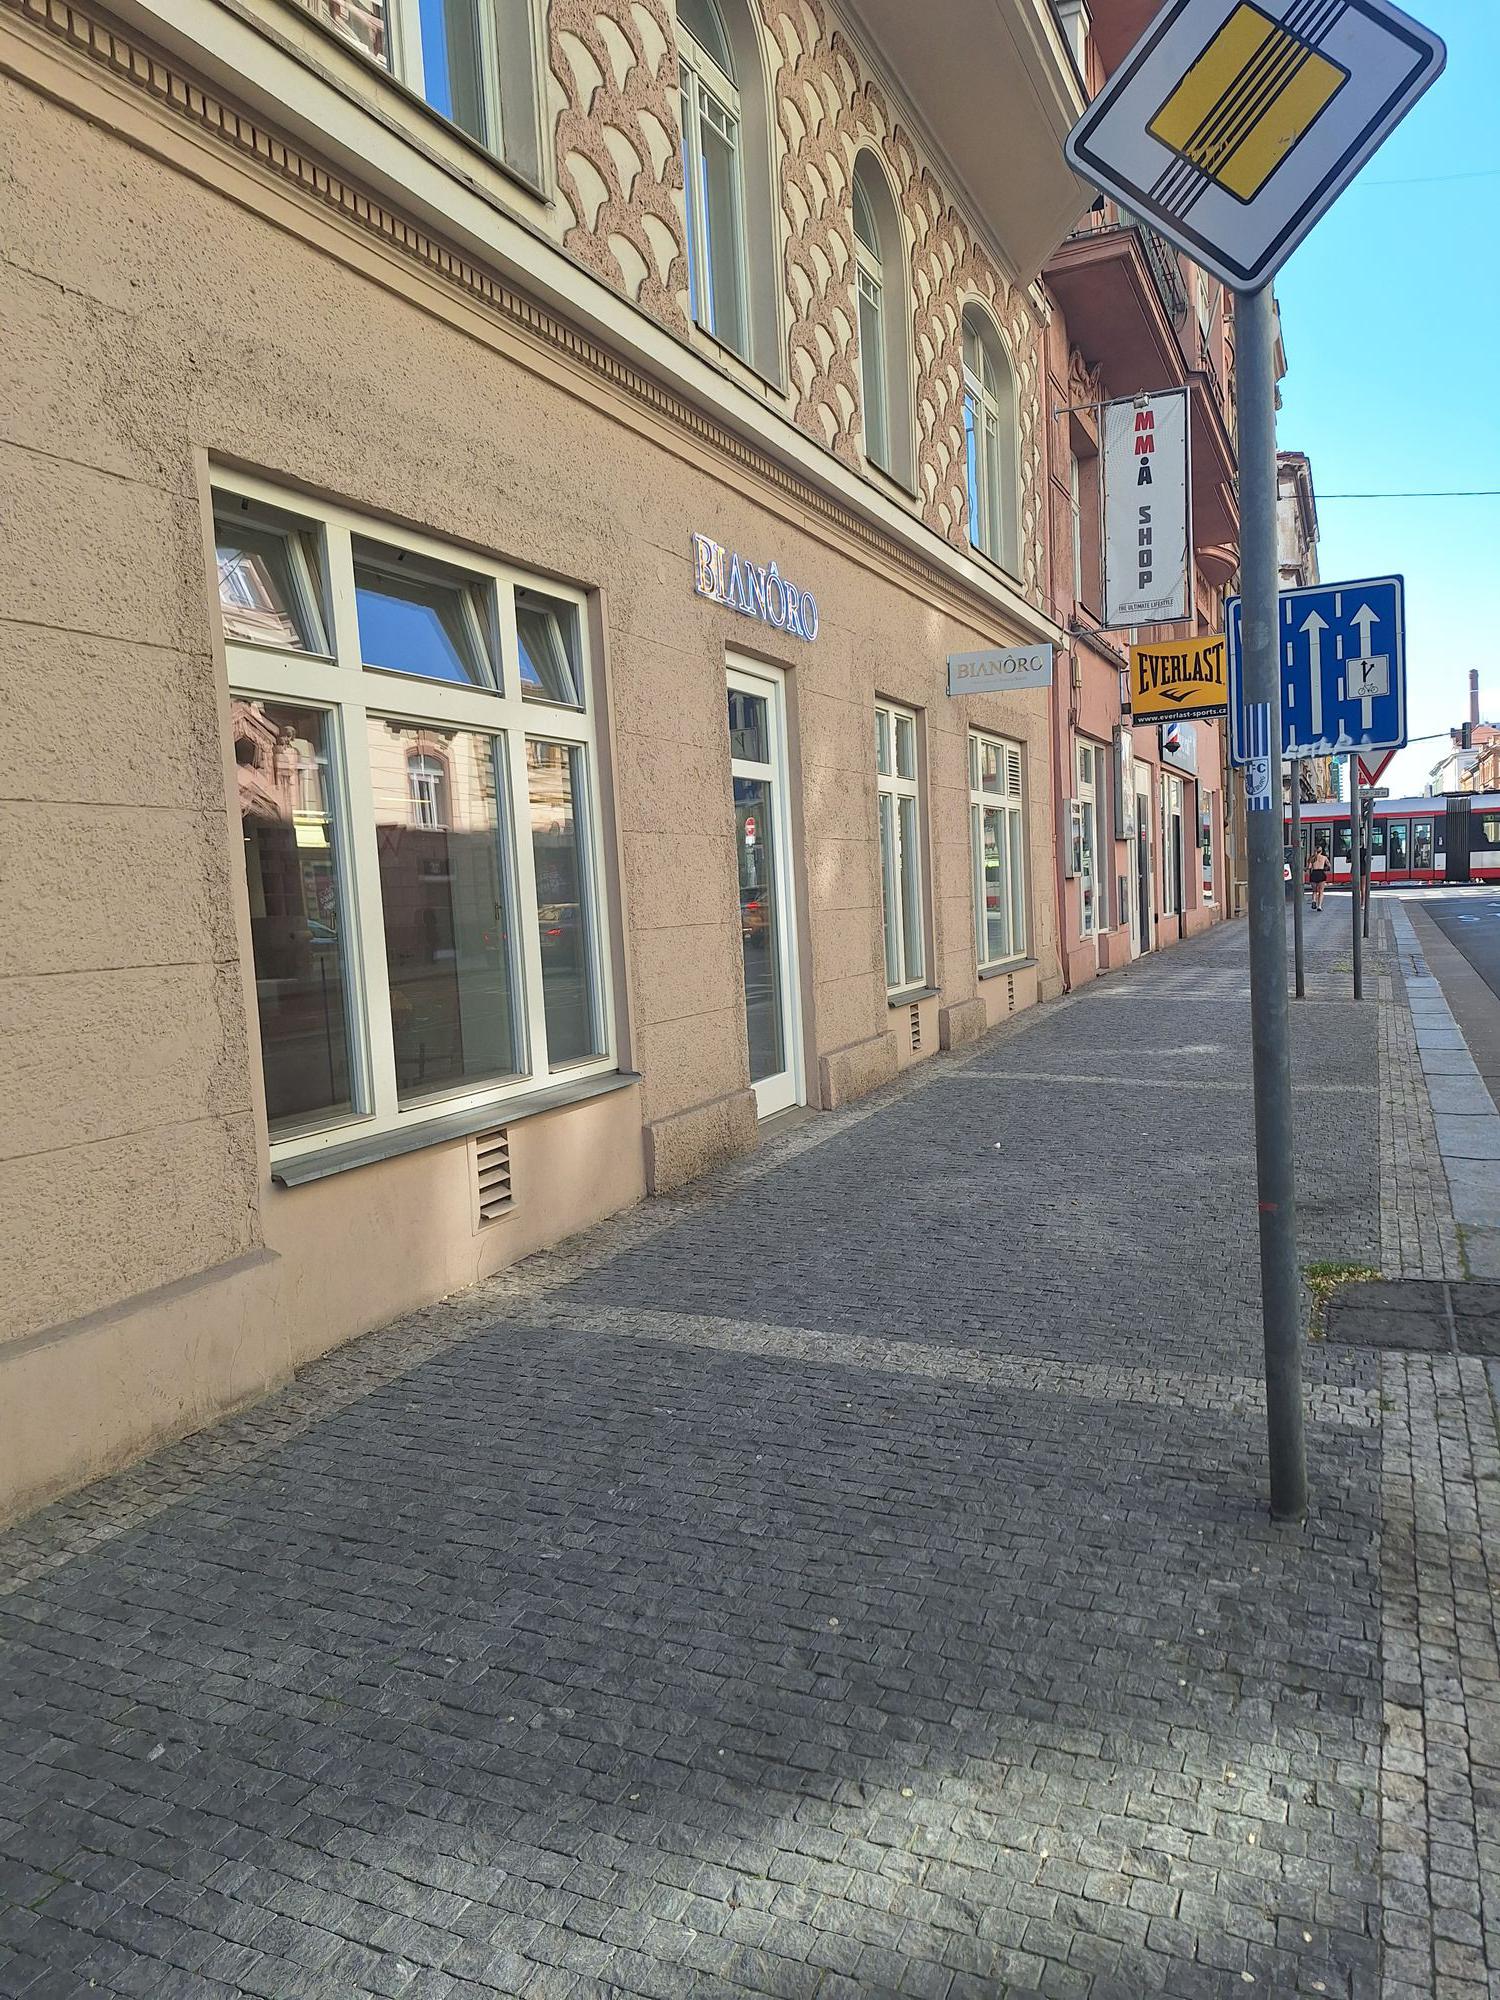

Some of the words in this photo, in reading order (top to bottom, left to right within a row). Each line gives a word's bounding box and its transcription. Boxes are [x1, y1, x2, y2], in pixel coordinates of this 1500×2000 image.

[1138, 505, 1153, 590] SHOP
[1136, 641, 1225, 695] EVERLAST
[1137, 708, 1227, 723] www.everlast-sports.cz
